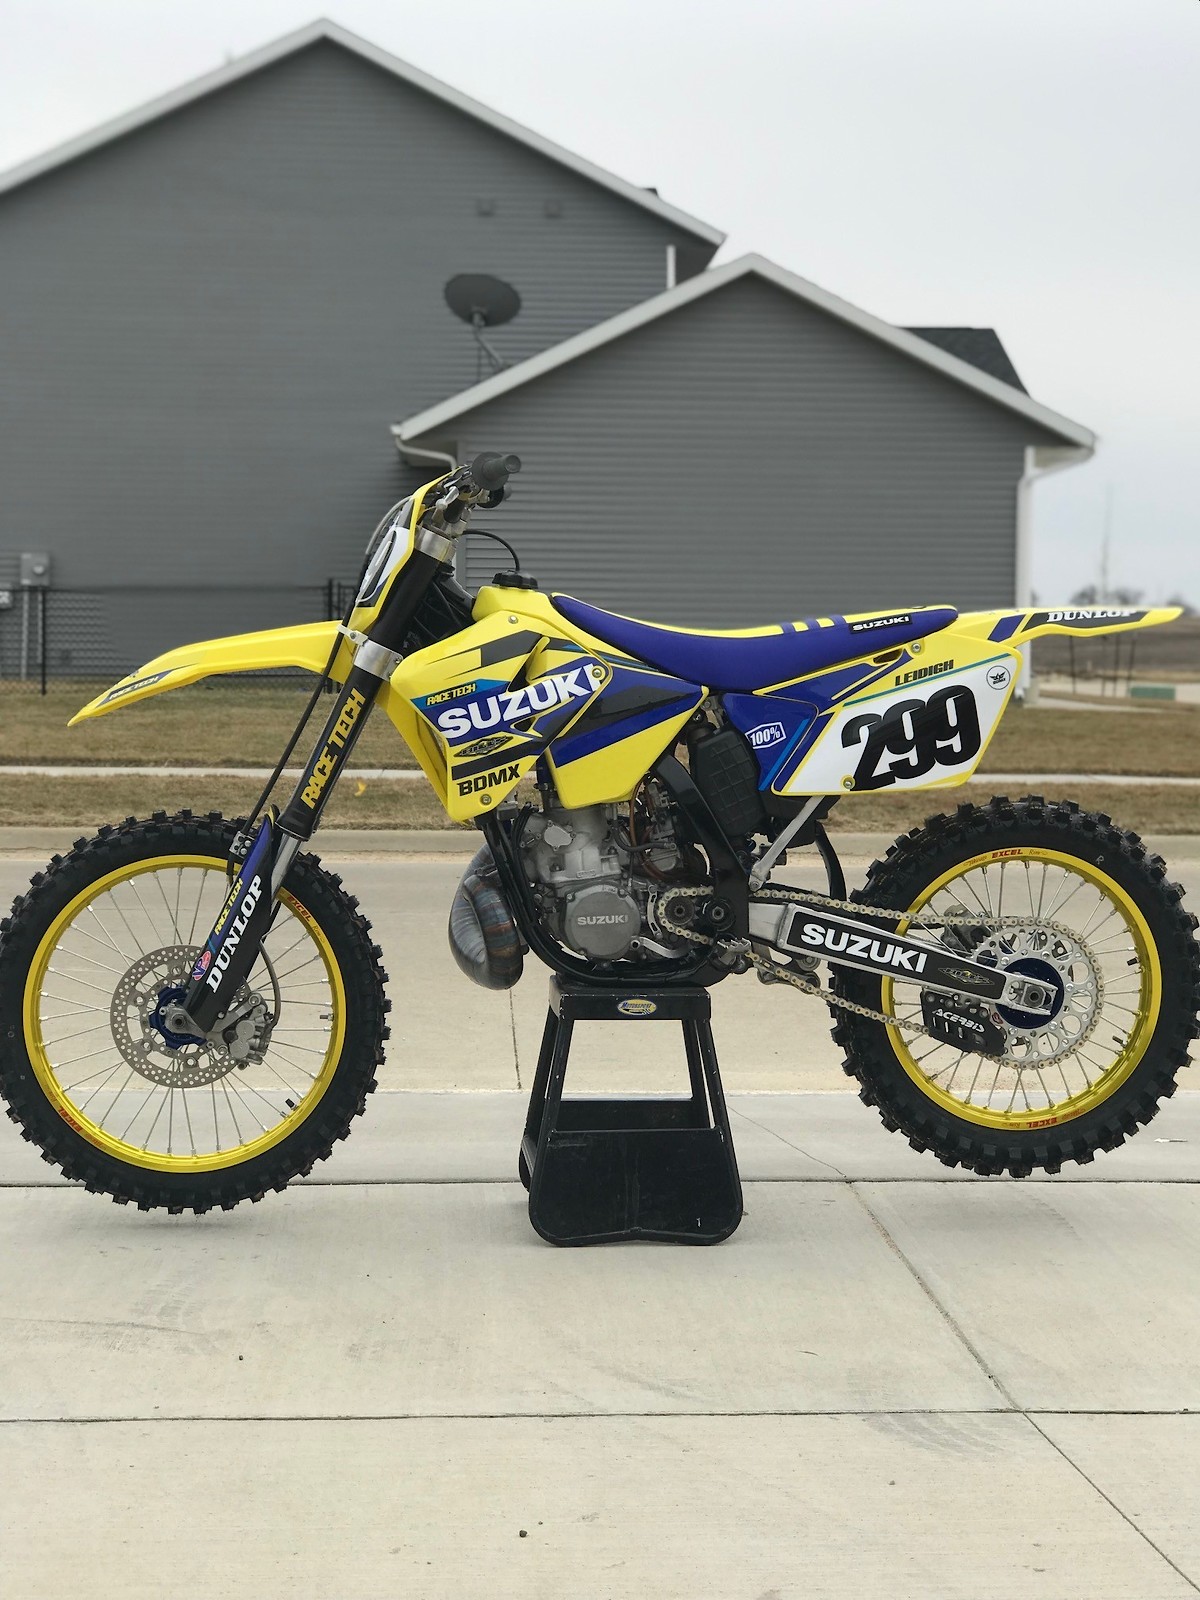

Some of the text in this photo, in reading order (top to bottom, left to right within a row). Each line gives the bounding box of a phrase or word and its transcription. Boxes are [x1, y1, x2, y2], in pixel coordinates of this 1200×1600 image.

[852, 615, 910, 631] SUZUKI
[1046, 610, 1136, 623] DUNLOP
[895, 660, 954, 687] LEIDIGH
[437, 663, 602, 739] SUZUKI
[300, 687, 366, 810] RACE TECH
[750, 725, 781, 746] 100%
[841, 685, 981, 792] 299
[457, 763, 521, 797] BDMX
[992, 849, 1023, 858] EXCEL
[287, 895, 311, 922] EXCEL
[577, 914, 629, 926] SUZUKI
[205, 874, 262, 993] DUNLOP
[800, 923, 928, 973] SUZUKI
[1026, 1117, 1058, 1129] EXCEL
